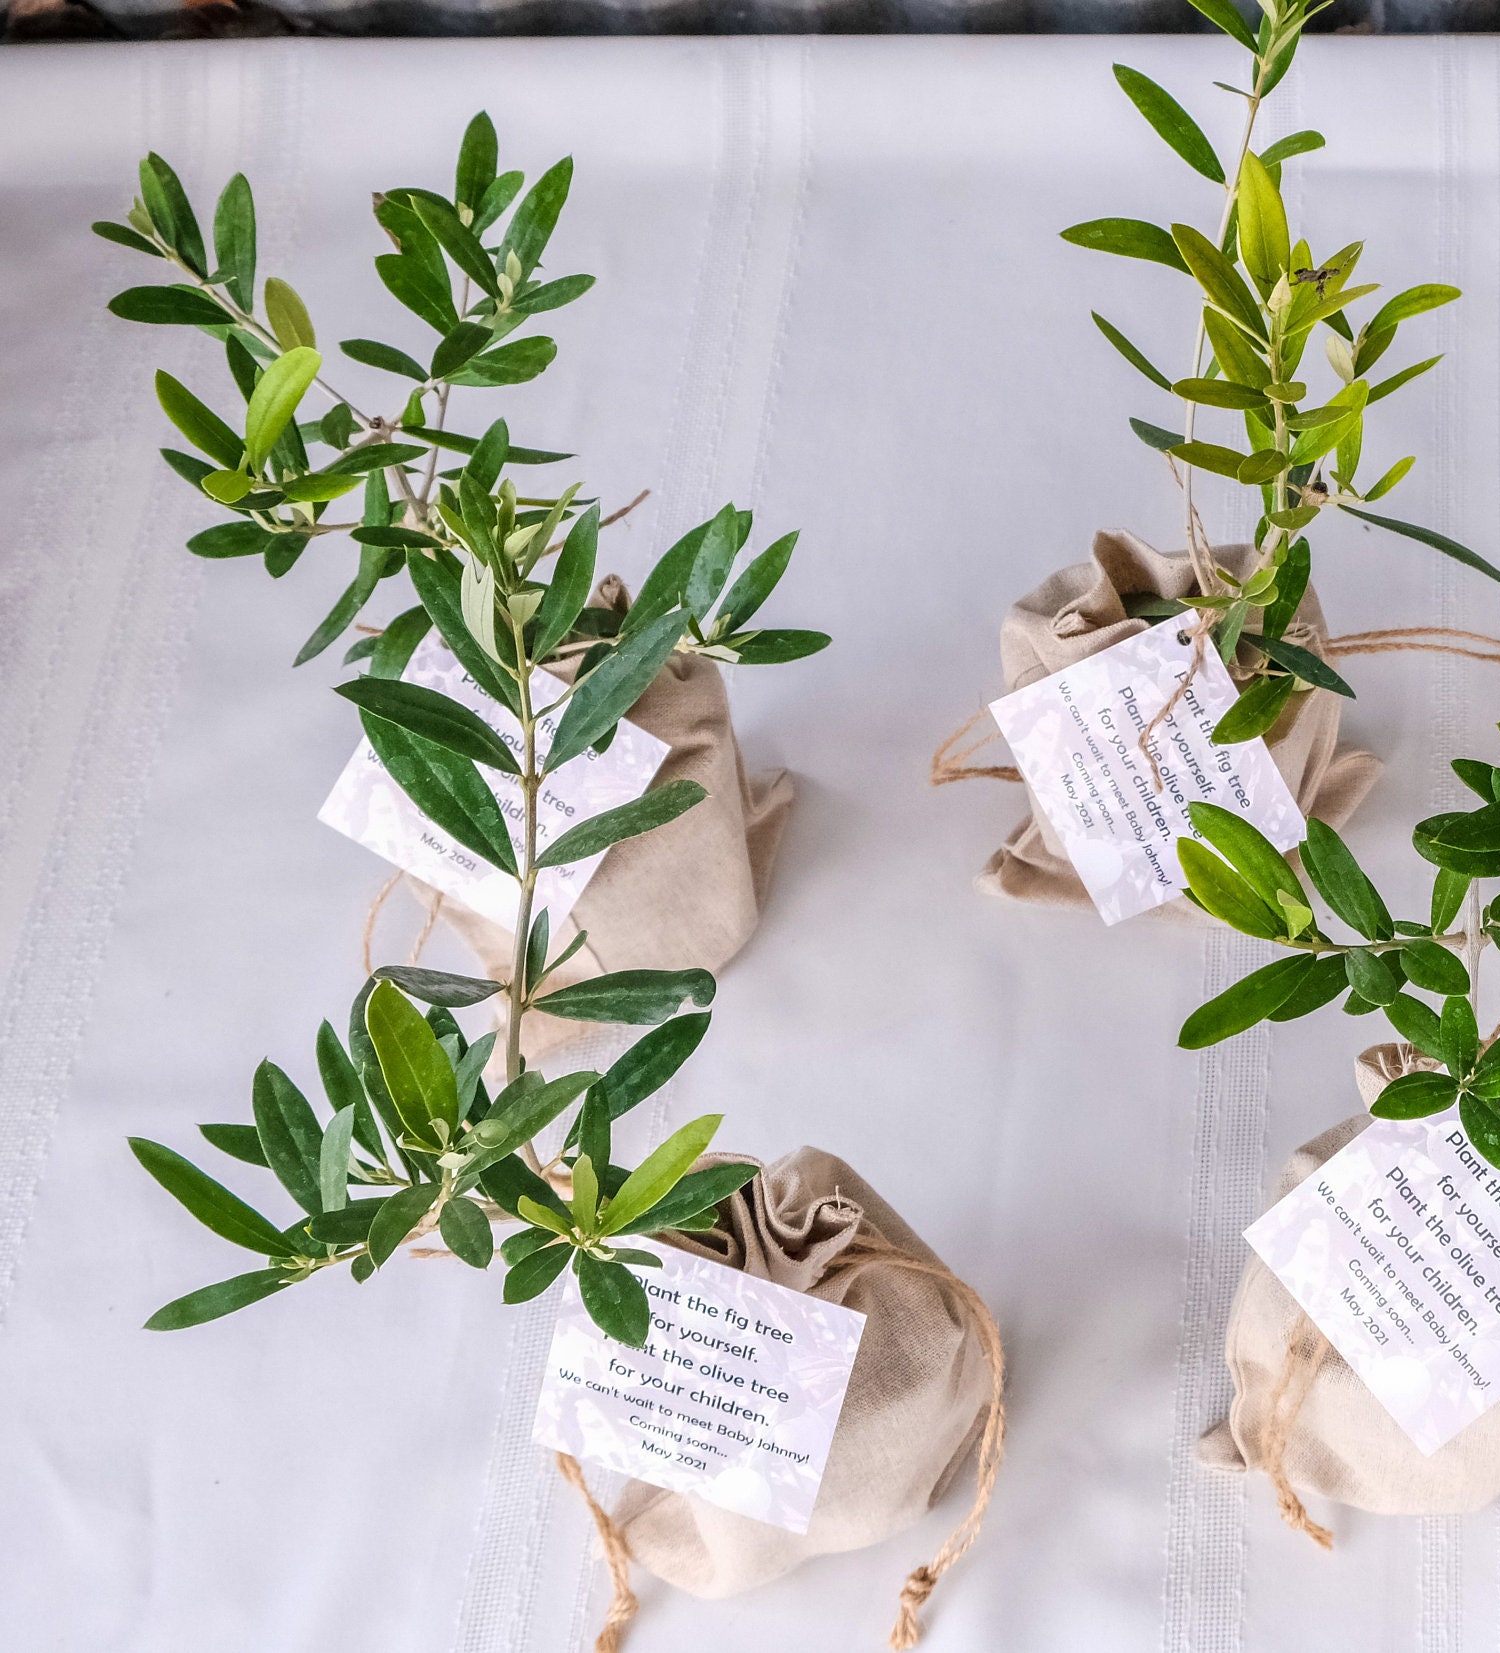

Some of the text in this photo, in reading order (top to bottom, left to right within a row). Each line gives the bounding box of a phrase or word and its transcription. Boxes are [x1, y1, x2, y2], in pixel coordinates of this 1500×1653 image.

[1118, 686, 1148, 733] Plant
[1160, 762, 1185, 804] olive
[1164, 712, 1217, 799] or yourself.
[543, 790, 575, 817] tree
[1058, 681, 1172, 887] We can't wait to meet Baby Johnny!
[1061, 773, 1094, 829] May 2021
[1072, 752, 1116, 834] Coming soon...
[1098, 708, 1170, 842] for your children.
[1215, 750, 1233, 774] fig
[1229, 775, 1250, 809] tree
[420, 832, 478, 872] May 2021
[1445, 1130, 1489, 1183] Plant
[1437, 1174, 1461, 1201] for
[1386, 1166, 1429, 1217] Plant
[1425, 1213, 1451, 1247] the
[1450, 1246, 1486, 1288] olive
[1317, 1181, 1491, 1391] We can't wait to meet Baby Johnny!
[1367, 1197, 1479, 1337] for your children.
[687, 1296, 719, 1318] the
[724, 1307, 750, 1330] fig
[754, 1318, 794, 1344] tree
[1340, 1287, 1390, 1346] May 2021
[1348, 1258, 1415, 1345] Coming soon...
[650, 1312, 676, 1332] for
[679, 1326, 759, 1364] yourself.
[608, 1358, 770, 1427] for your children.
[662, 1346, 790, 1403] the olive tree
[559, 1368, 810, 1464] We can't wait to meet Baby Johnny!
[629, 1414, 728, 1458] Coming soon...
[641, 1440, 708, 1471] May 2021
